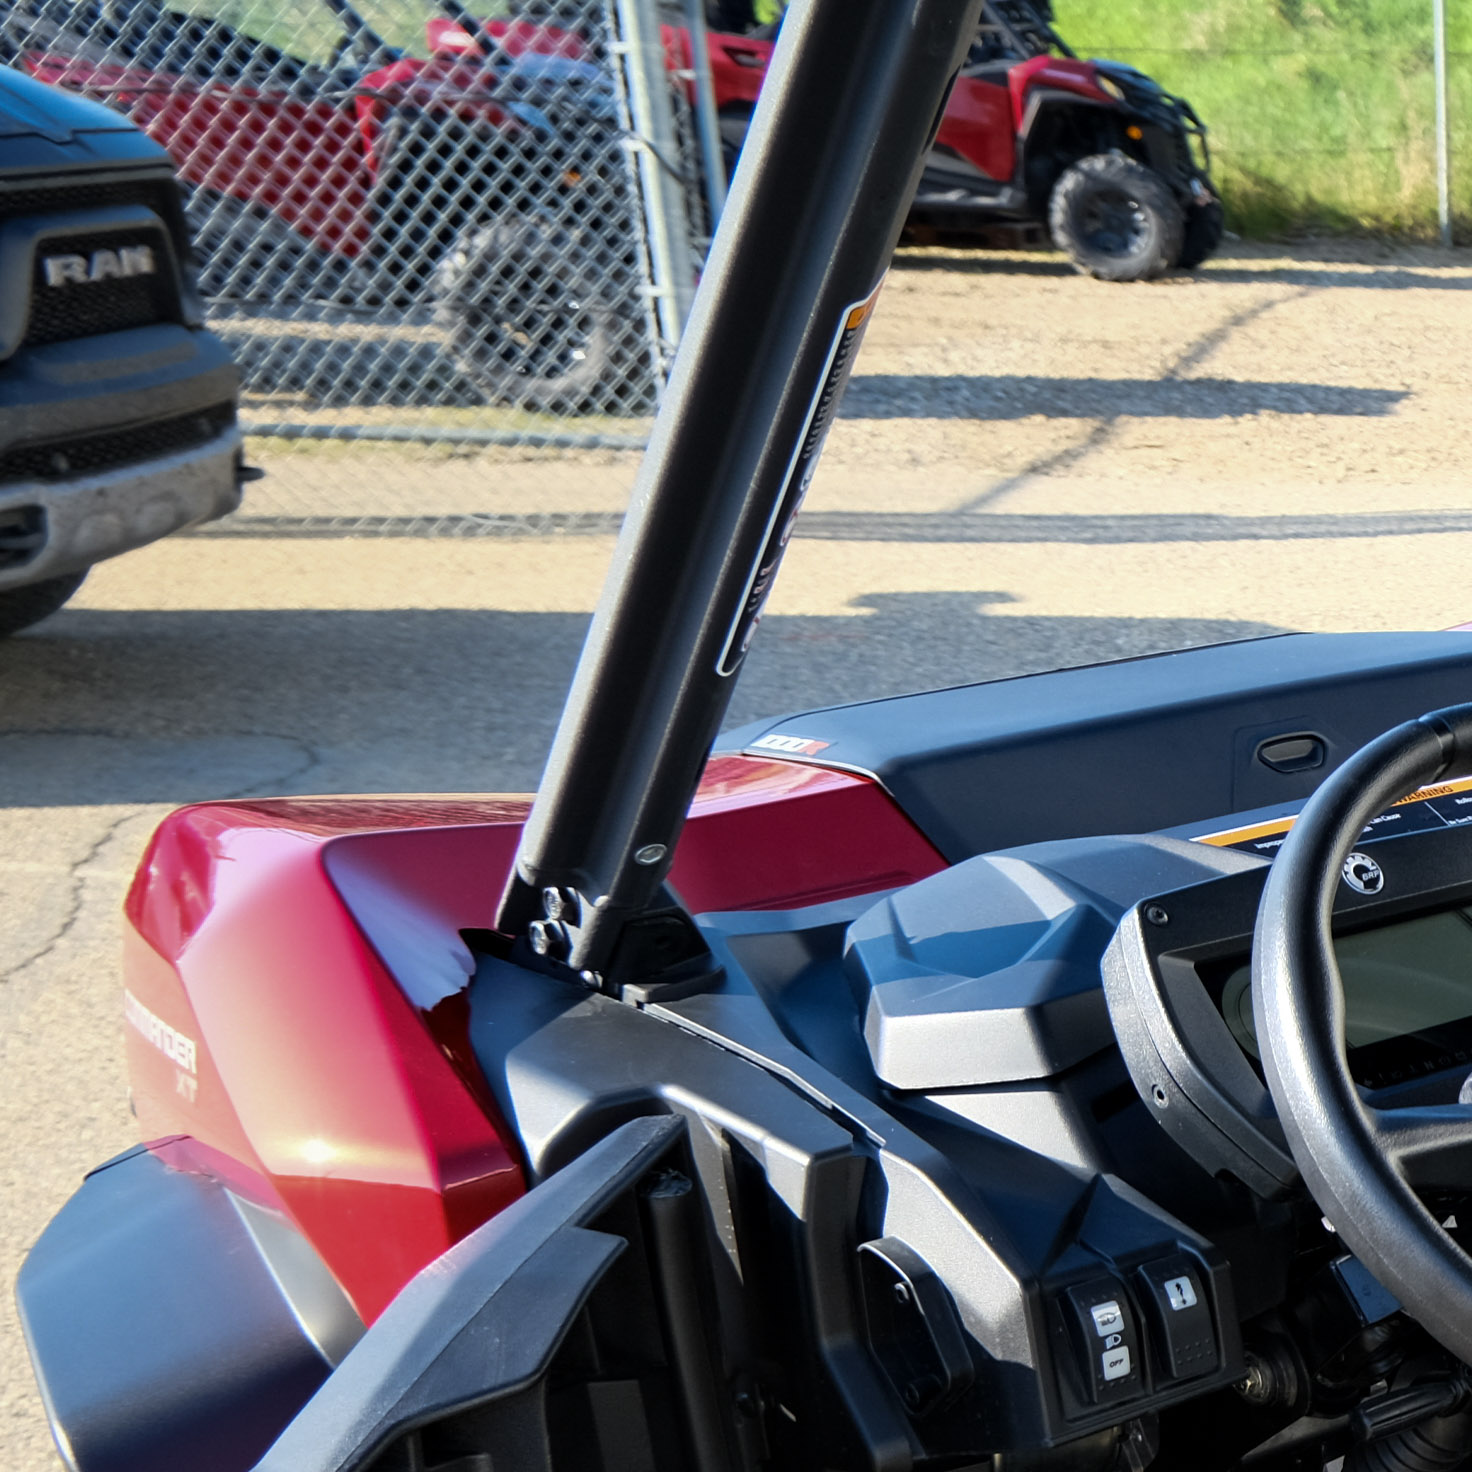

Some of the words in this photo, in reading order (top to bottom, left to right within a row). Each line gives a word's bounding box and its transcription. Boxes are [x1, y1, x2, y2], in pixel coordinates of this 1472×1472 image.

[44, 245, 155, 287] RAM
[1398, 786, 1453, 803] WARNING
[1362, 870, 1380, 881] BRP
[176, 1068, 198, 1102] XT
[1109, 1358, 1124, 1368] OFF
